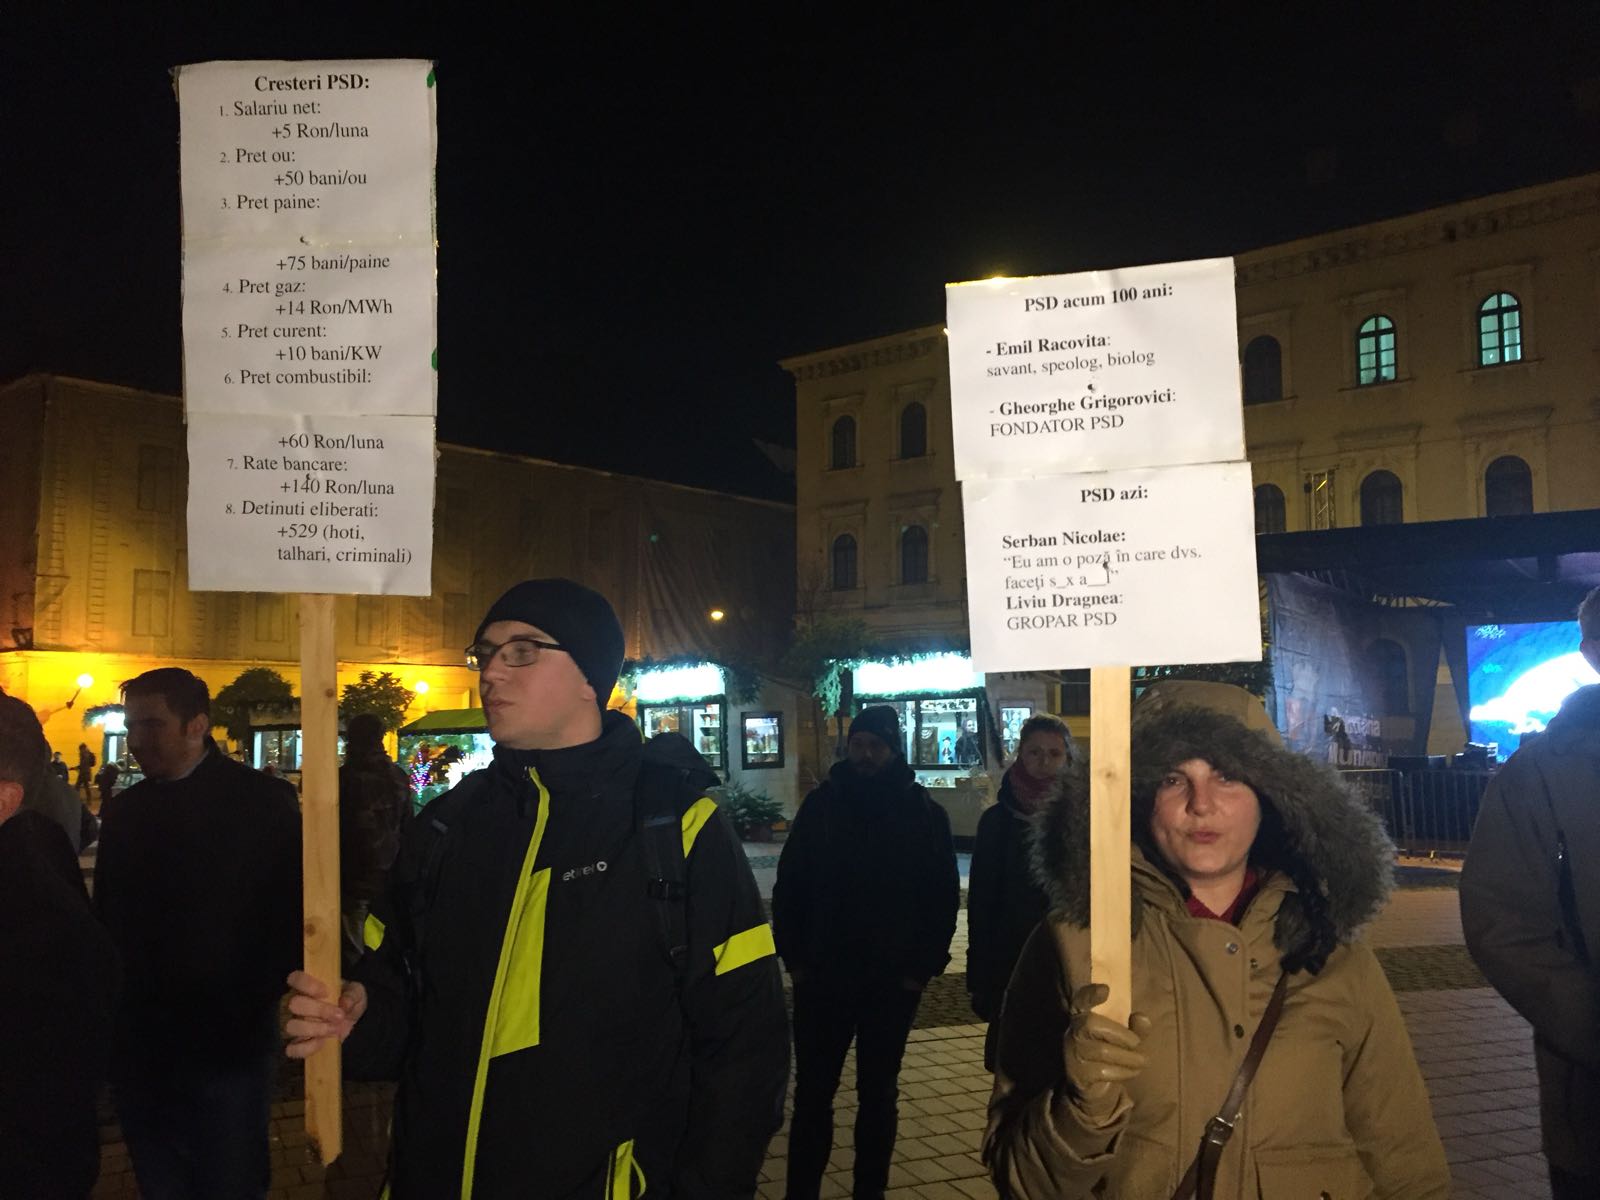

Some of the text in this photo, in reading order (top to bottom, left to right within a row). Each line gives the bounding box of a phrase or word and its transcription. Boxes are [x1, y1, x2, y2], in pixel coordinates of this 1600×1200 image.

[255, 74, 369, 91] Cresteri PSD:
[220, 100, 320, 116] 1. Salariu net:
[272, 122, 368, 138] +5 Ron/luna
[220, 148, 295, 163] 2. Pret ou:
[274, 170, 366, 185] +50 bani/ou
[221, 194, 319, 213] 3. Pret paine:
[277, 254, 389, 273] +75 bani/paine
[223, 279, 305, 297] 4. Pret gaz:
[1025, 283, 1172, 312] PSD acum 100 ani:
[276, 299, 392, 315] +14 Ron/MWh
[221, 324, 326, 338] 5. Pret curent:
[276, 346, 382, 360] +10 bani/KW
[997, 340, 1032, 356] Emil
[1039, 334, 1110, 352] Racovita:
[987, 351, 1154, 376] savant, speolog, biolog
[224, 369, 371, 384] 6. Pret combustibil:
[1000, 399, 1075, 415] Gheorghe
[1080, 387, 1175, 410] Grigorovici:
[991, 415, 1124, 437] FONDATOR PSD
[279, 434, 384, 449] +60 Ron/luna
[227, 456, 347, 471] 7. Rate bancare:
[281, 478, 394, 494] +140 Ron/luna
[1081, 486, 1148, 502] PSD azi:
[225, 501, 378, 517] 8. Detinuti eliberati:
[278, 524, 364, 540] +529 (hoti,
[1003, 530, 1125, 548] Serban Nicolae:
[278, 546, 411, 564] talhari, criminali)
[1037, 557, 1058, 567] am
[1063, 557, 1071, 565] o
[1135, 551, 1165, 561] care
[1171, 545, 1201, 559] dvs.
[1007, 594, 1122, 609] Liviu Dragnea:
[1007, 612, 1117, 630] GROPAR PSD
